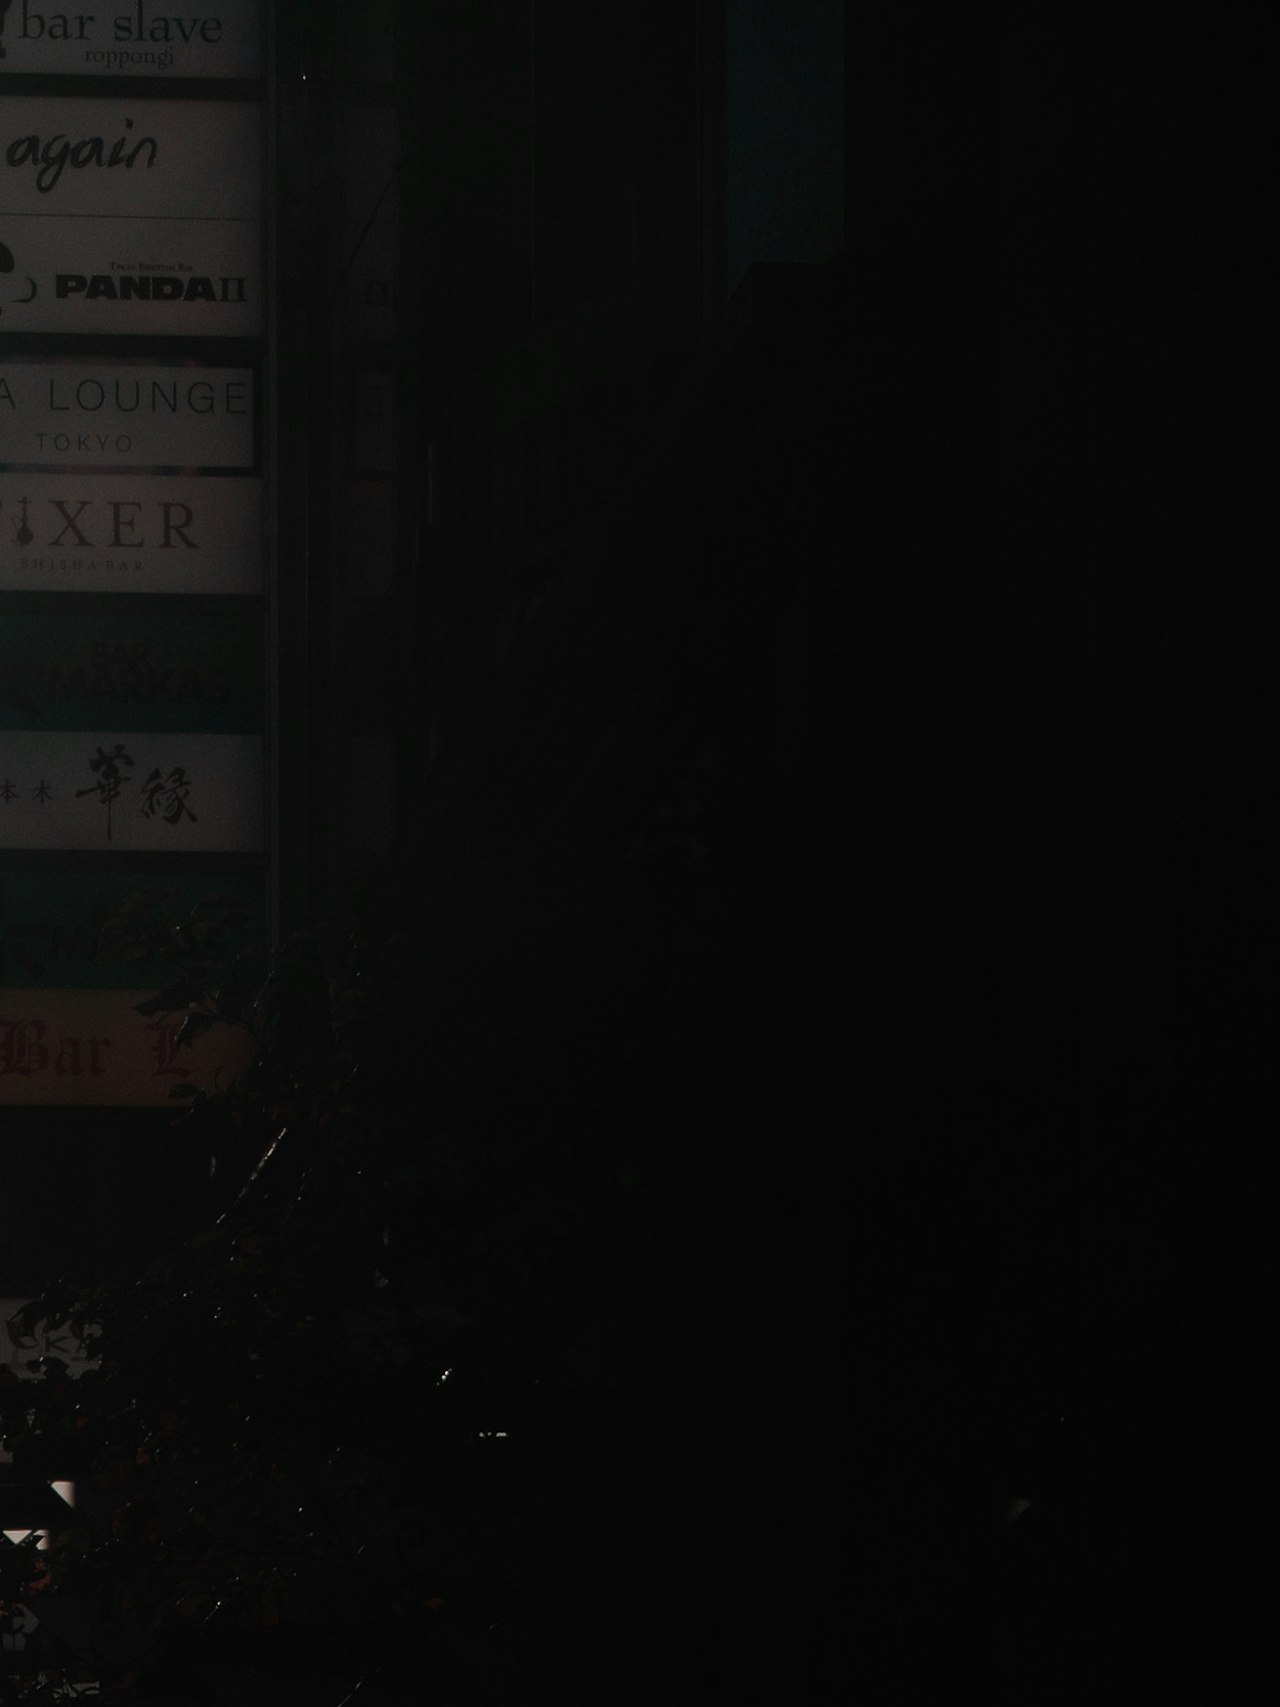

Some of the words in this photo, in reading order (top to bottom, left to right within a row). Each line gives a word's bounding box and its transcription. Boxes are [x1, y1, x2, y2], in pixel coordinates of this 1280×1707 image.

[19, 0, 95, 41] bar
[114, 0, 223, 43] slave
[85, 46, 176, 69] roppongi
[6, 117, 157, 193] again
[49, 378, 247, 415] LOUNGE
[35, 432, 133, 453] TOKYO
